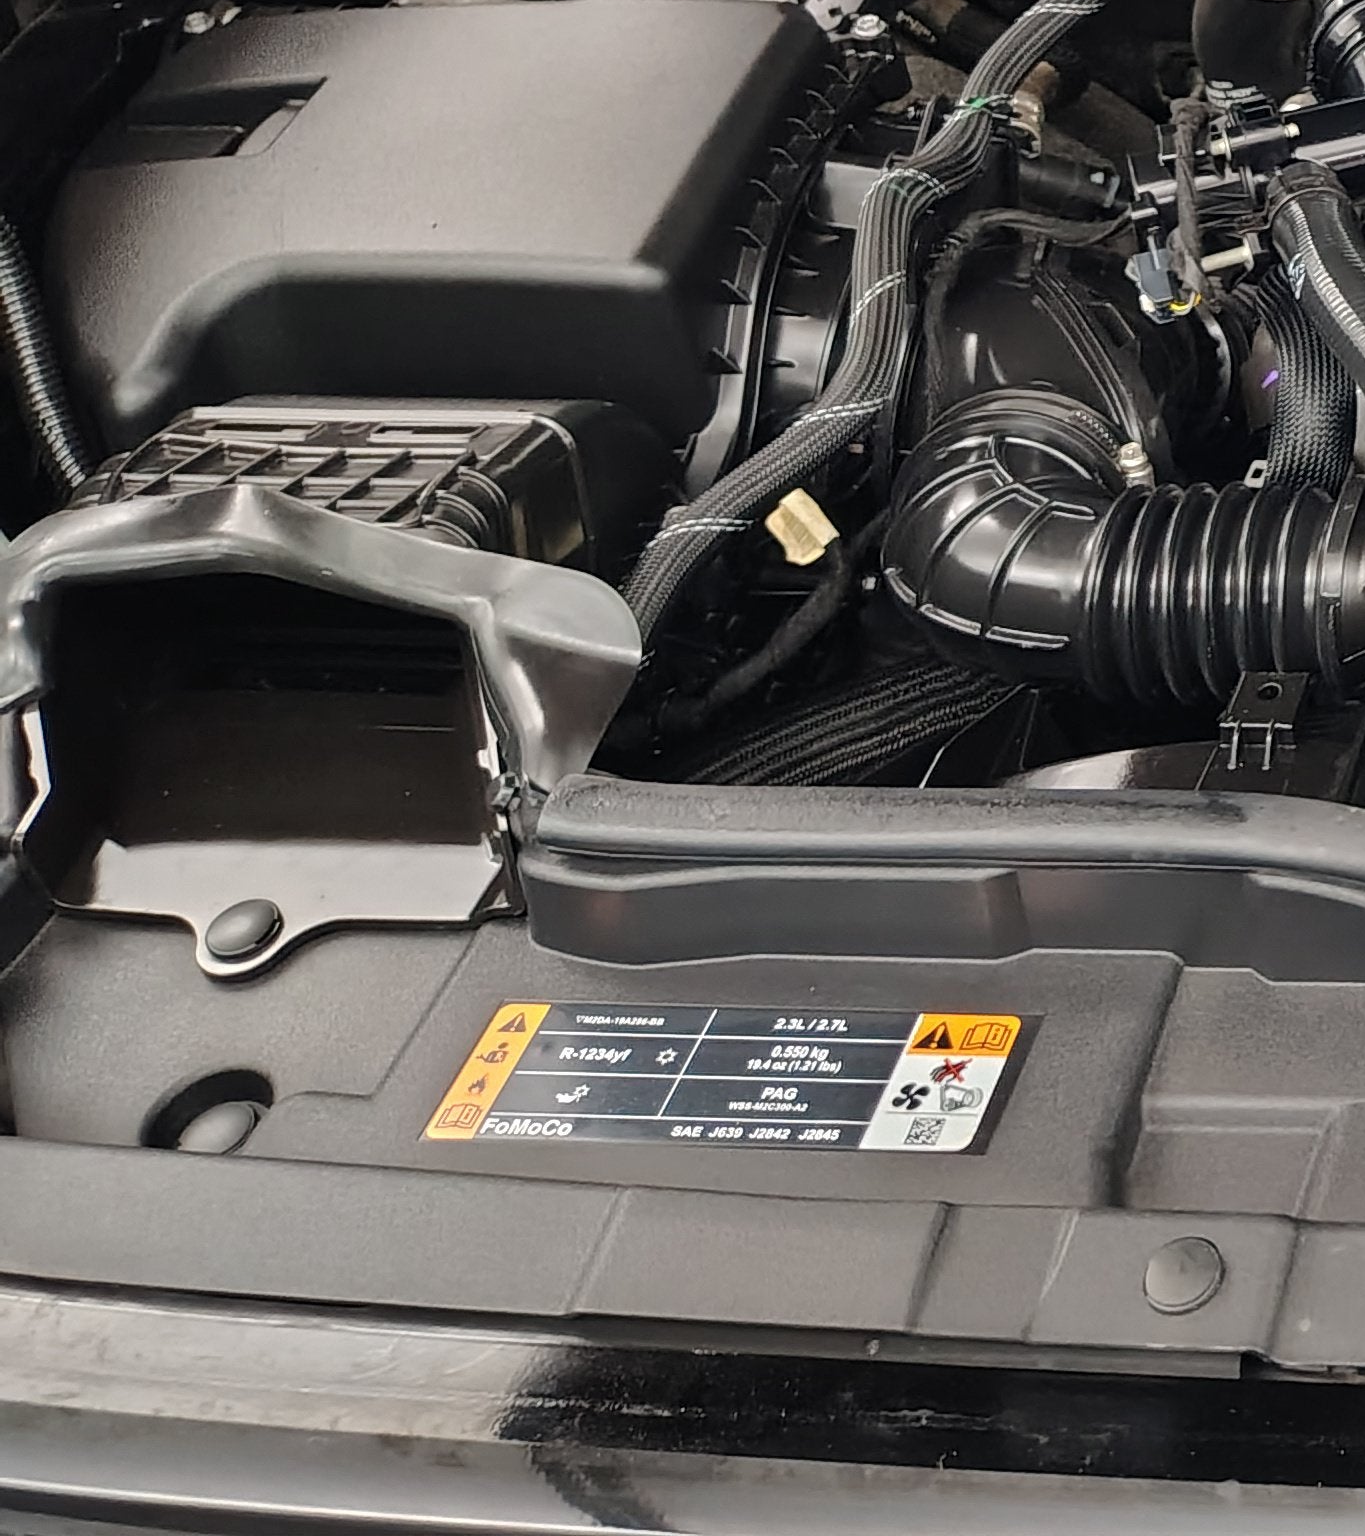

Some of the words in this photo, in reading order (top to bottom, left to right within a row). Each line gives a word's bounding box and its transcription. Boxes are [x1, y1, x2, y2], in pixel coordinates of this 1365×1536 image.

[773, 1018, 806, 1031] 2.3L
[816, 1019, 848, 1032] 2.7L
[559, 1047, 633, 1064] R-1234yf
[771, 1044, 810, 1059] 0.550
[809, 1046, 830, 1062] kg
[747, 1058, 770, 1071] 19.4
[771, 1061, 786, 1070] oz
[761, 1087, 799, 1100] PAG
[480, 1119, 573, 1136] FoMoCo
[670, 1125, 703, 1138] SAE
[708, 1126, 743, 1139] J639
[749, 1126, 791, 1141] J2842
[798, 1127, 841, 1141] J2845
